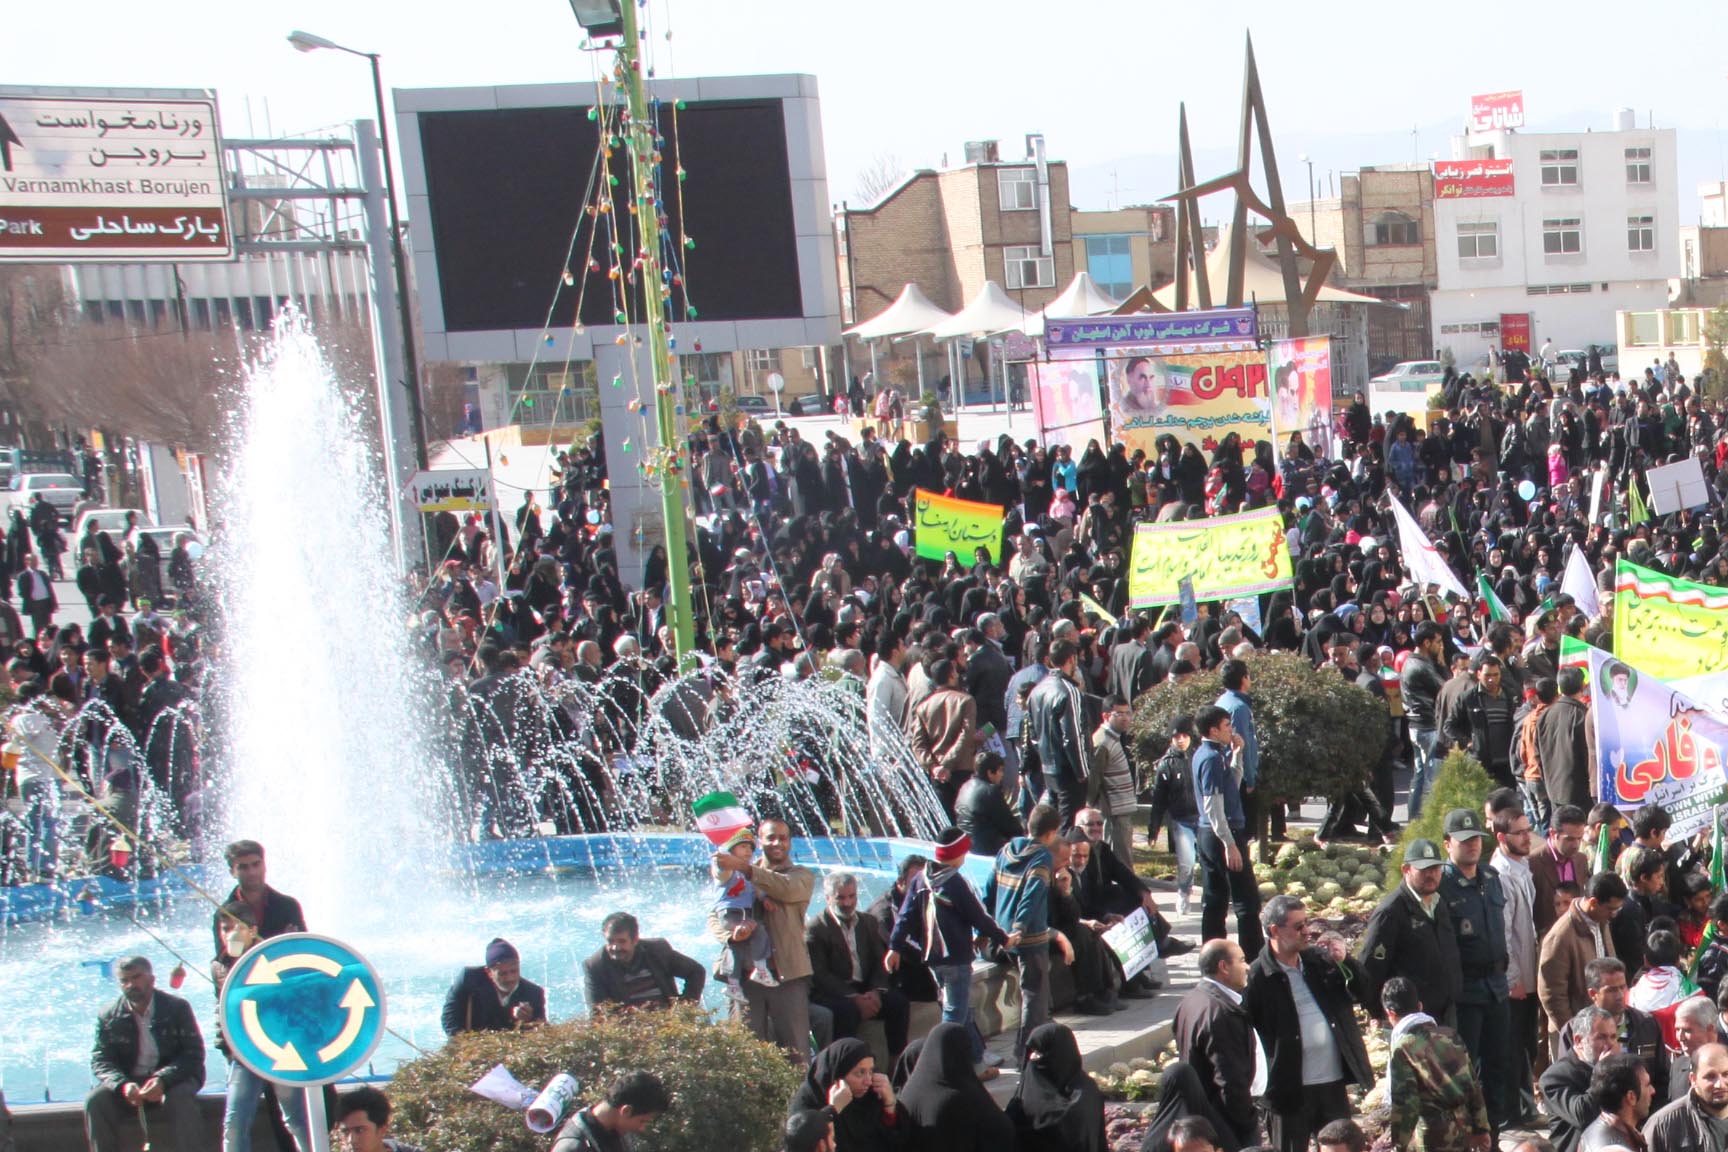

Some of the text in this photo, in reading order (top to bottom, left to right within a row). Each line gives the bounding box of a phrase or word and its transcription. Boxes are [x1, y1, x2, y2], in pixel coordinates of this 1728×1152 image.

[88, 147, 207, 167] بروجن
[3, 177, 211, 198] Varnamkhast Borujen
[69, 215, 221, 243] پارک ساحلی
[1195, 321, 1231, 336] شرکت
